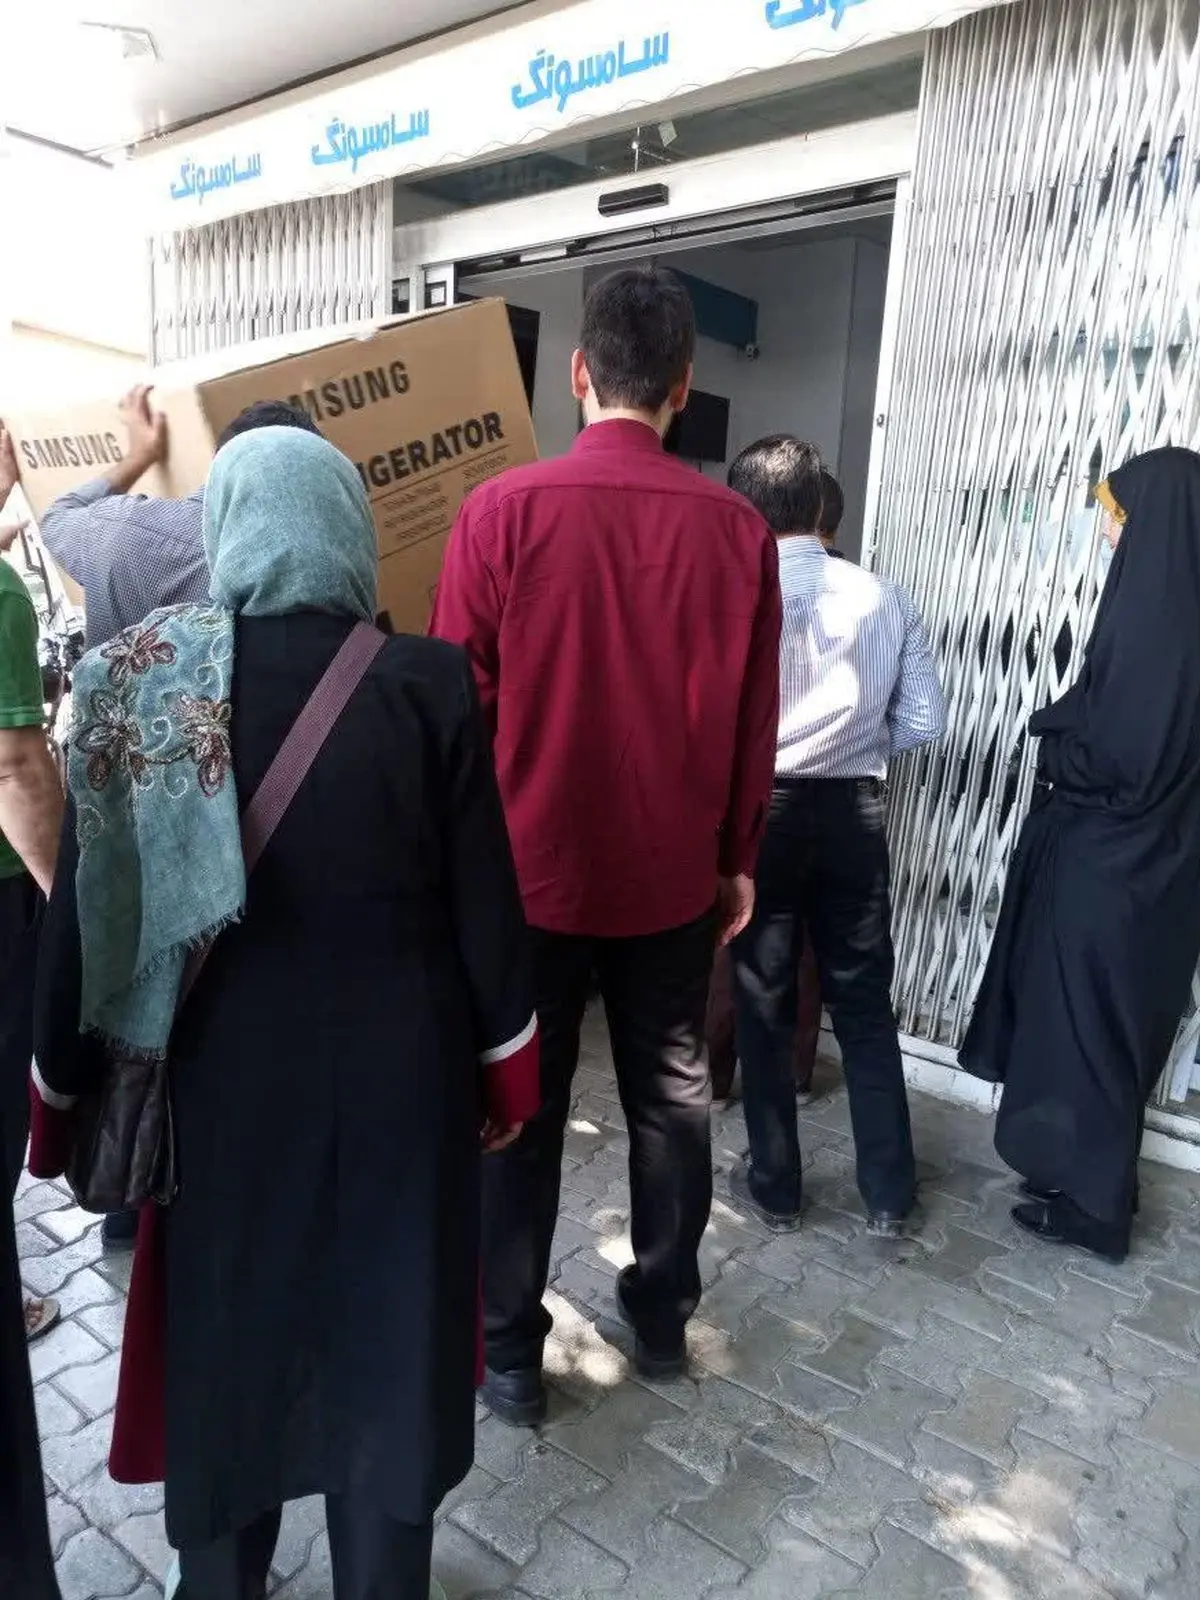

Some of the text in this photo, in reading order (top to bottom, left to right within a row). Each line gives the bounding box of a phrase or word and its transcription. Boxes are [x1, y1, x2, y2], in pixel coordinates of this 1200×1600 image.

[510, 30, 670, 112] سامسونگ
[310, 109, 430, 173] سامسونگ
[170, 152, 262, 204] سامسونگ
[286, 359, 411, 422] MSUNG
[20, 431, 124, 470] SAMSUNG
